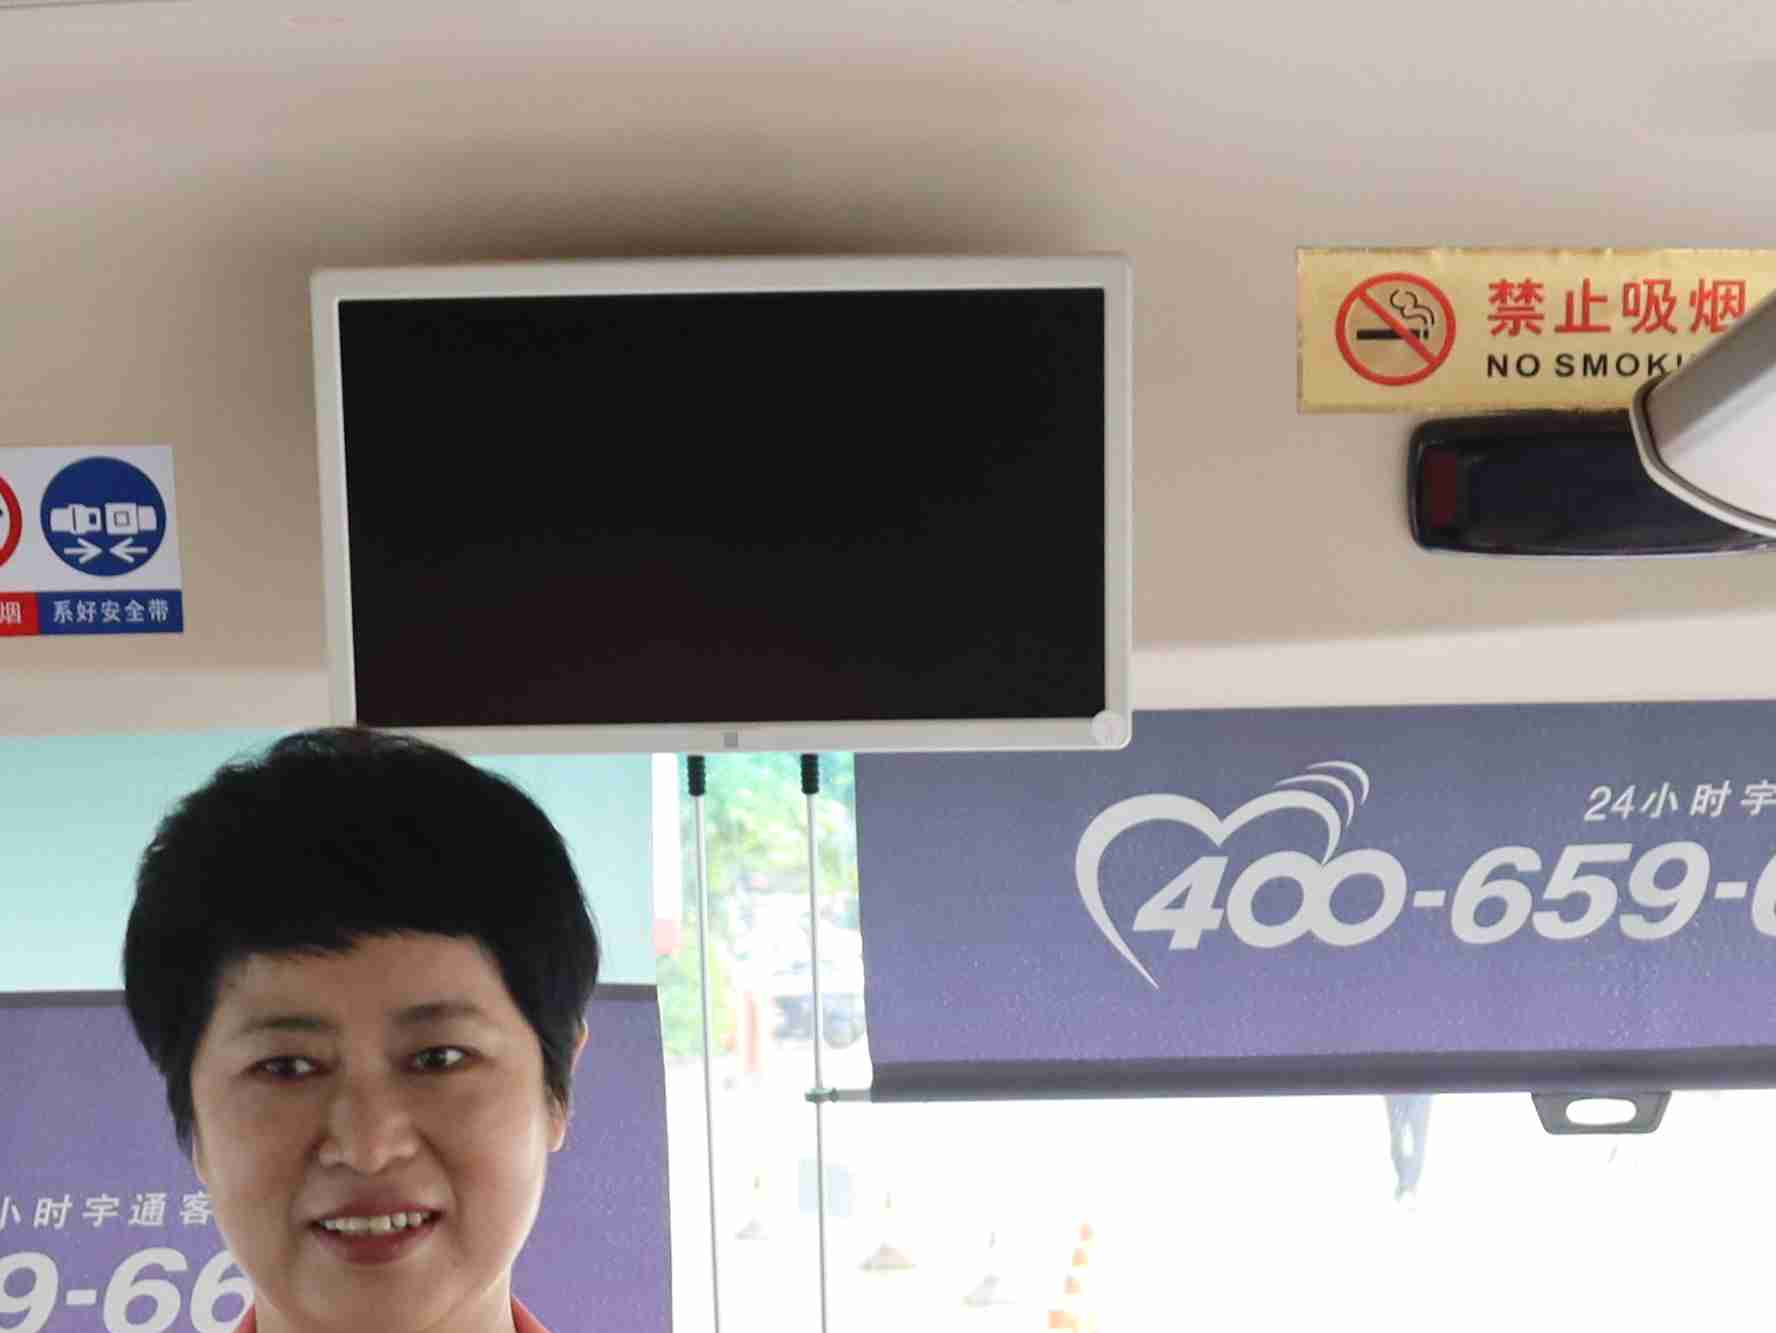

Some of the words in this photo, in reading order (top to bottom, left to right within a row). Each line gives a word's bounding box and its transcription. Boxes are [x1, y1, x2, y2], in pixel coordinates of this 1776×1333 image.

[1487, 277, 1746, 337] 禁止吸烟
[1487, 353, 1541, 377] NO
[52, 599, 169, 625] 系好安全带
